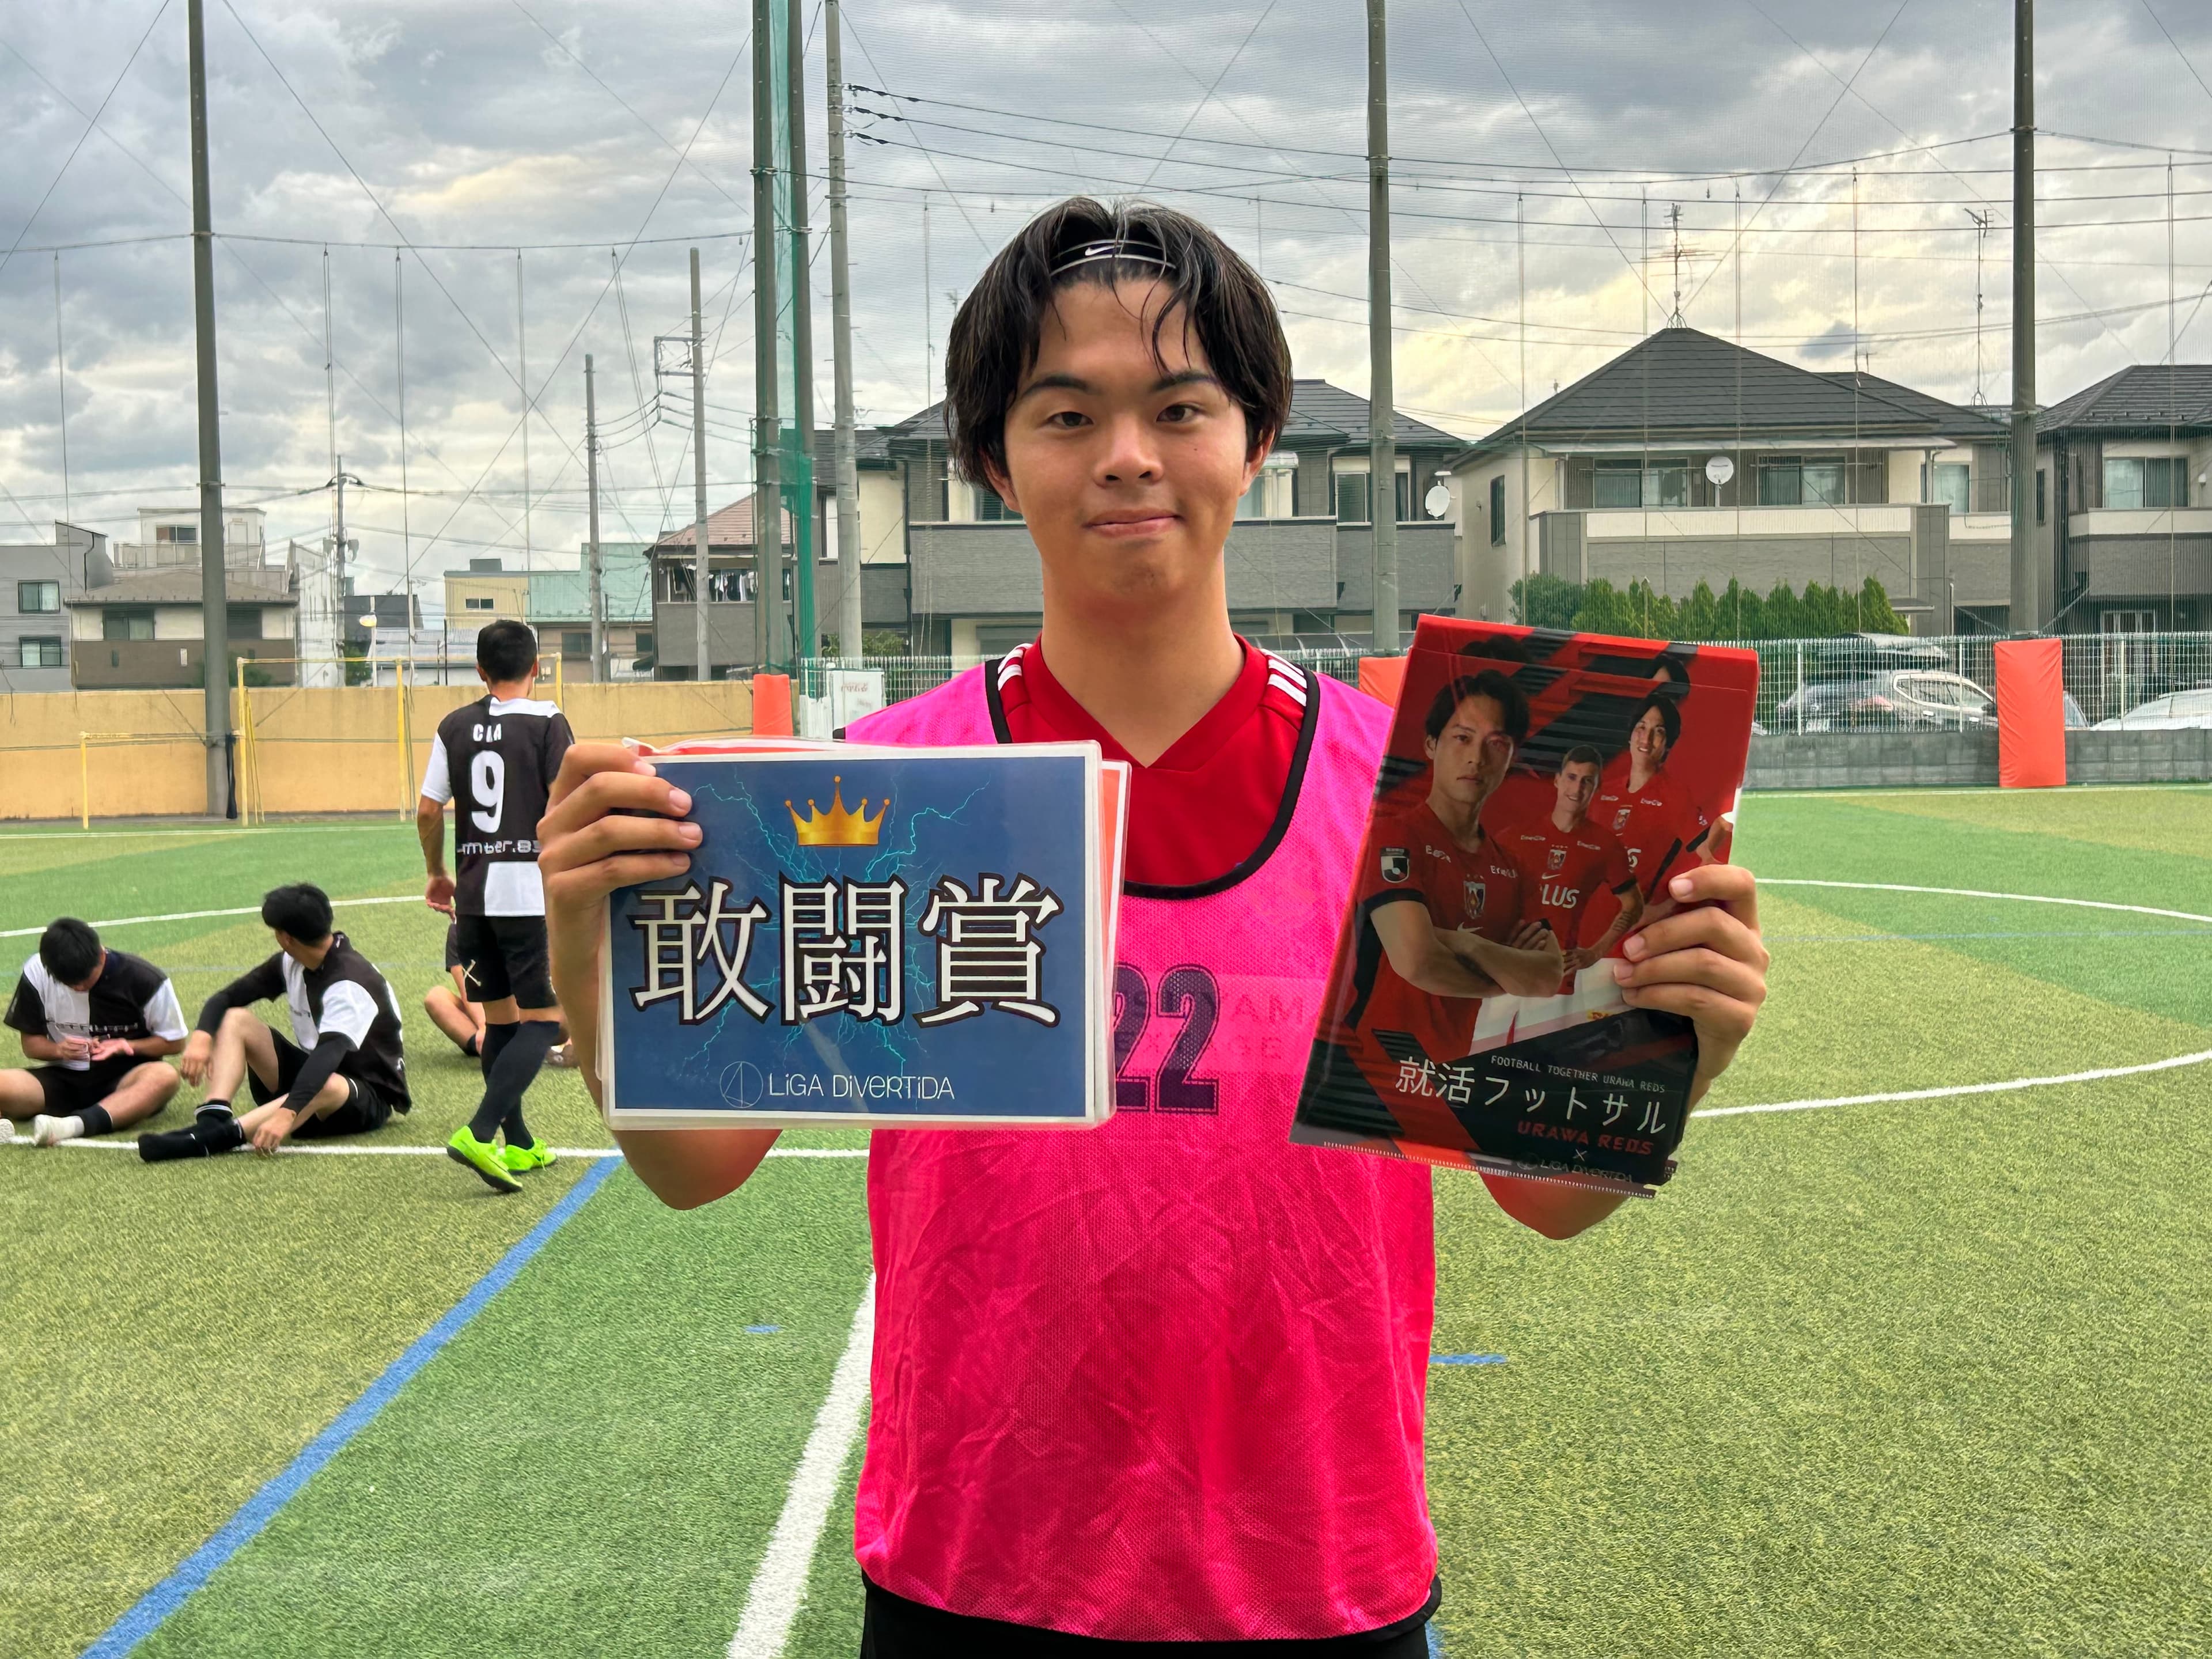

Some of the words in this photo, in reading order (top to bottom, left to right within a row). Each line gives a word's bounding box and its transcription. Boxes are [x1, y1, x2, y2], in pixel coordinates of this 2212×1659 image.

[471, 750, 505, 834] 9
[1540, 884, 1580, 909] LUS
[631, 872, 1063, 1027] 敢闘賞
[1115, 962, 1220, 1115] 22
[1491, 1055, 1541, 1073] FOOTBALL
[1547, 1065, 1599, 1082] TOGETHER
[1603, 1075, 1635, 1088] URAWA
[1640, 1081, 1665, 1093] REDS
[1395, 1056, 1666, 1134] 就活フットサル
[1517, 1120, 1589, 1145] URAWA
[1597, 1134, 1654, 1155] REDS
